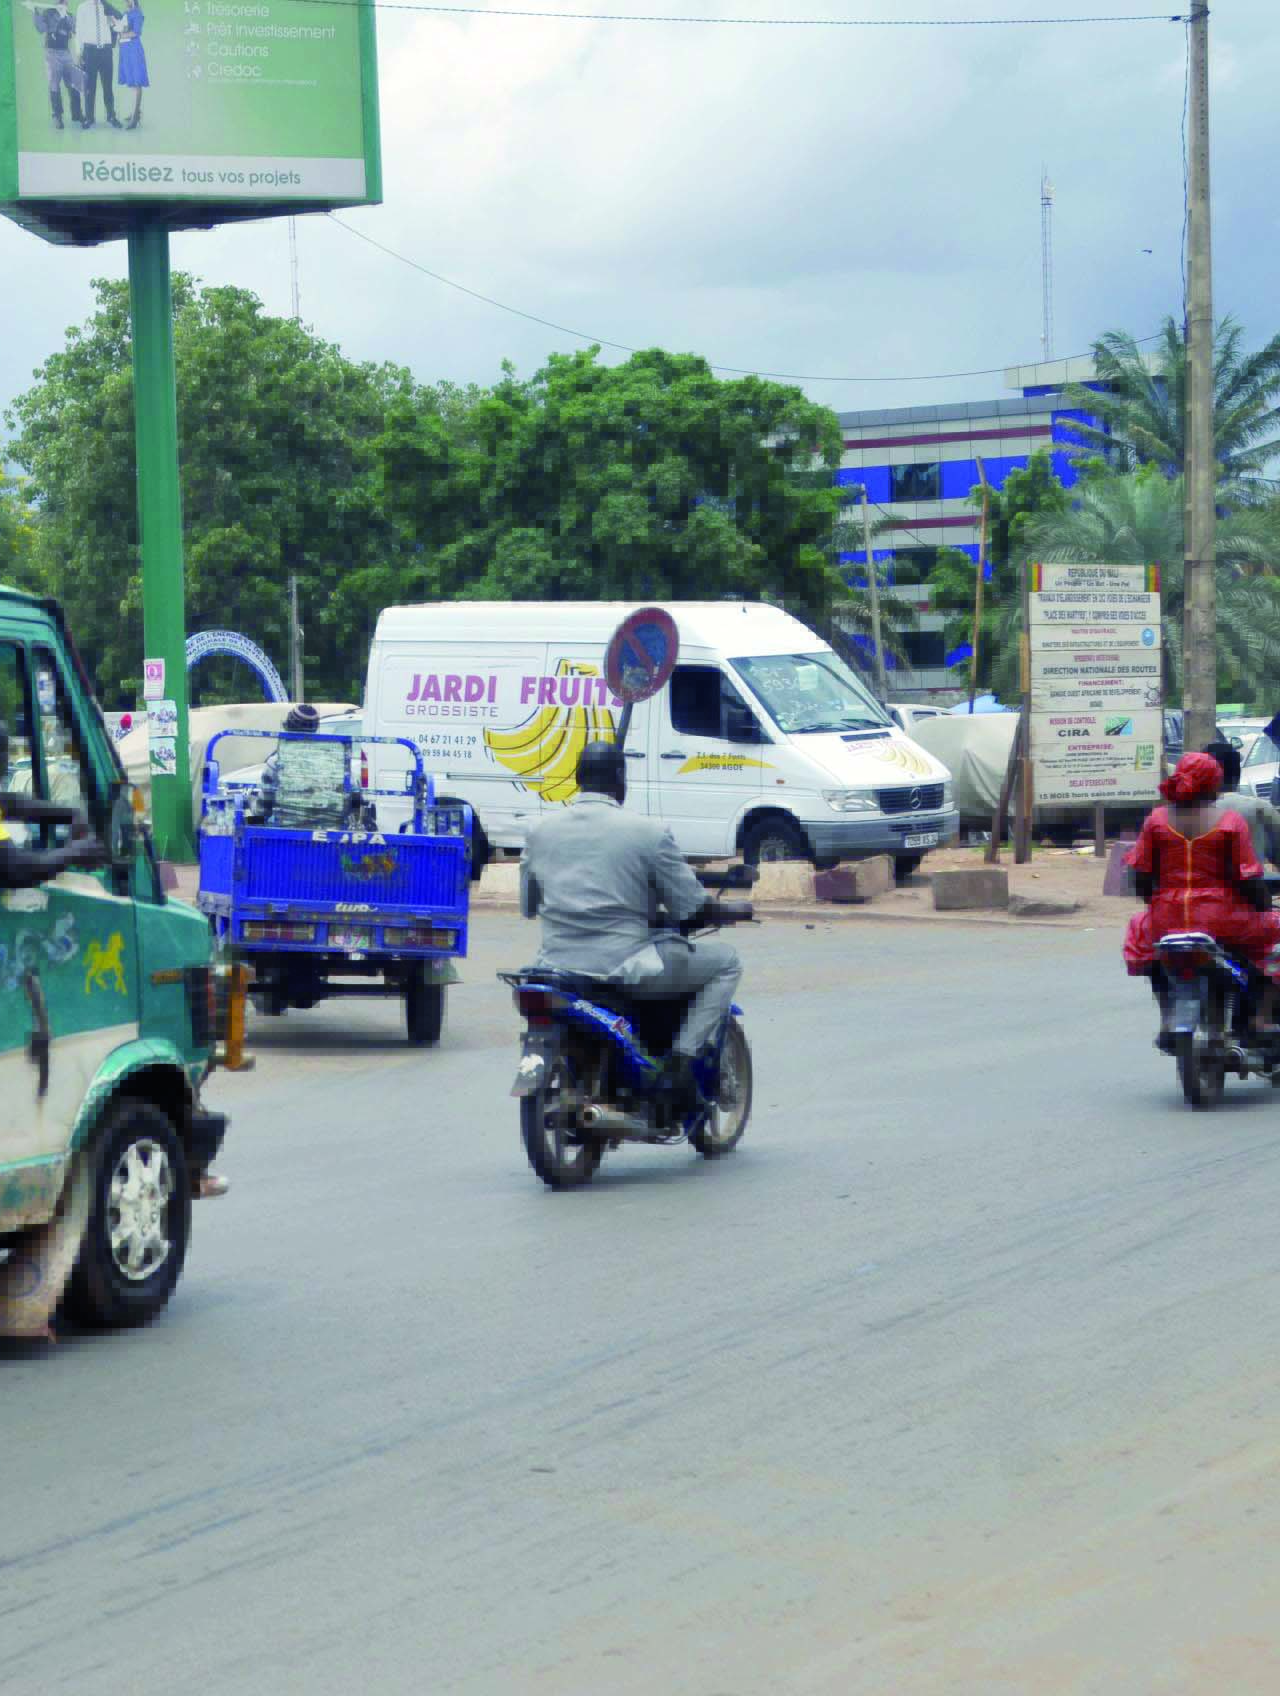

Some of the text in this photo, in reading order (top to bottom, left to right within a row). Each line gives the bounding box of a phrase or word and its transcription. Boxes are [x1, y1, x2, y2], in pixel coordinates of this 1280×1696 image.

[236, 24, 336, 38] Investissement
[208, 42, 269, 57] Cautions
[82, 160, 301, 187] Réalisez tous vos projets
[1043, 667, 1079, 675] DIRECTION
[1131, 665, 1157, 673] ROUTES
[406, 674, 498, 703] JARDI
[405, 704, 499, 718] GROSSISTE
[418, 734, 428, 744] 04
[431, 734, 440, 744] 67
[442, 735, 451, 745] 21
[454, 735, 463, 745] 41
[467, 735, 477, 745] 29
[1058, 729, 1091, 737] CIRA
[722, 763, 744, 771] AGDE
